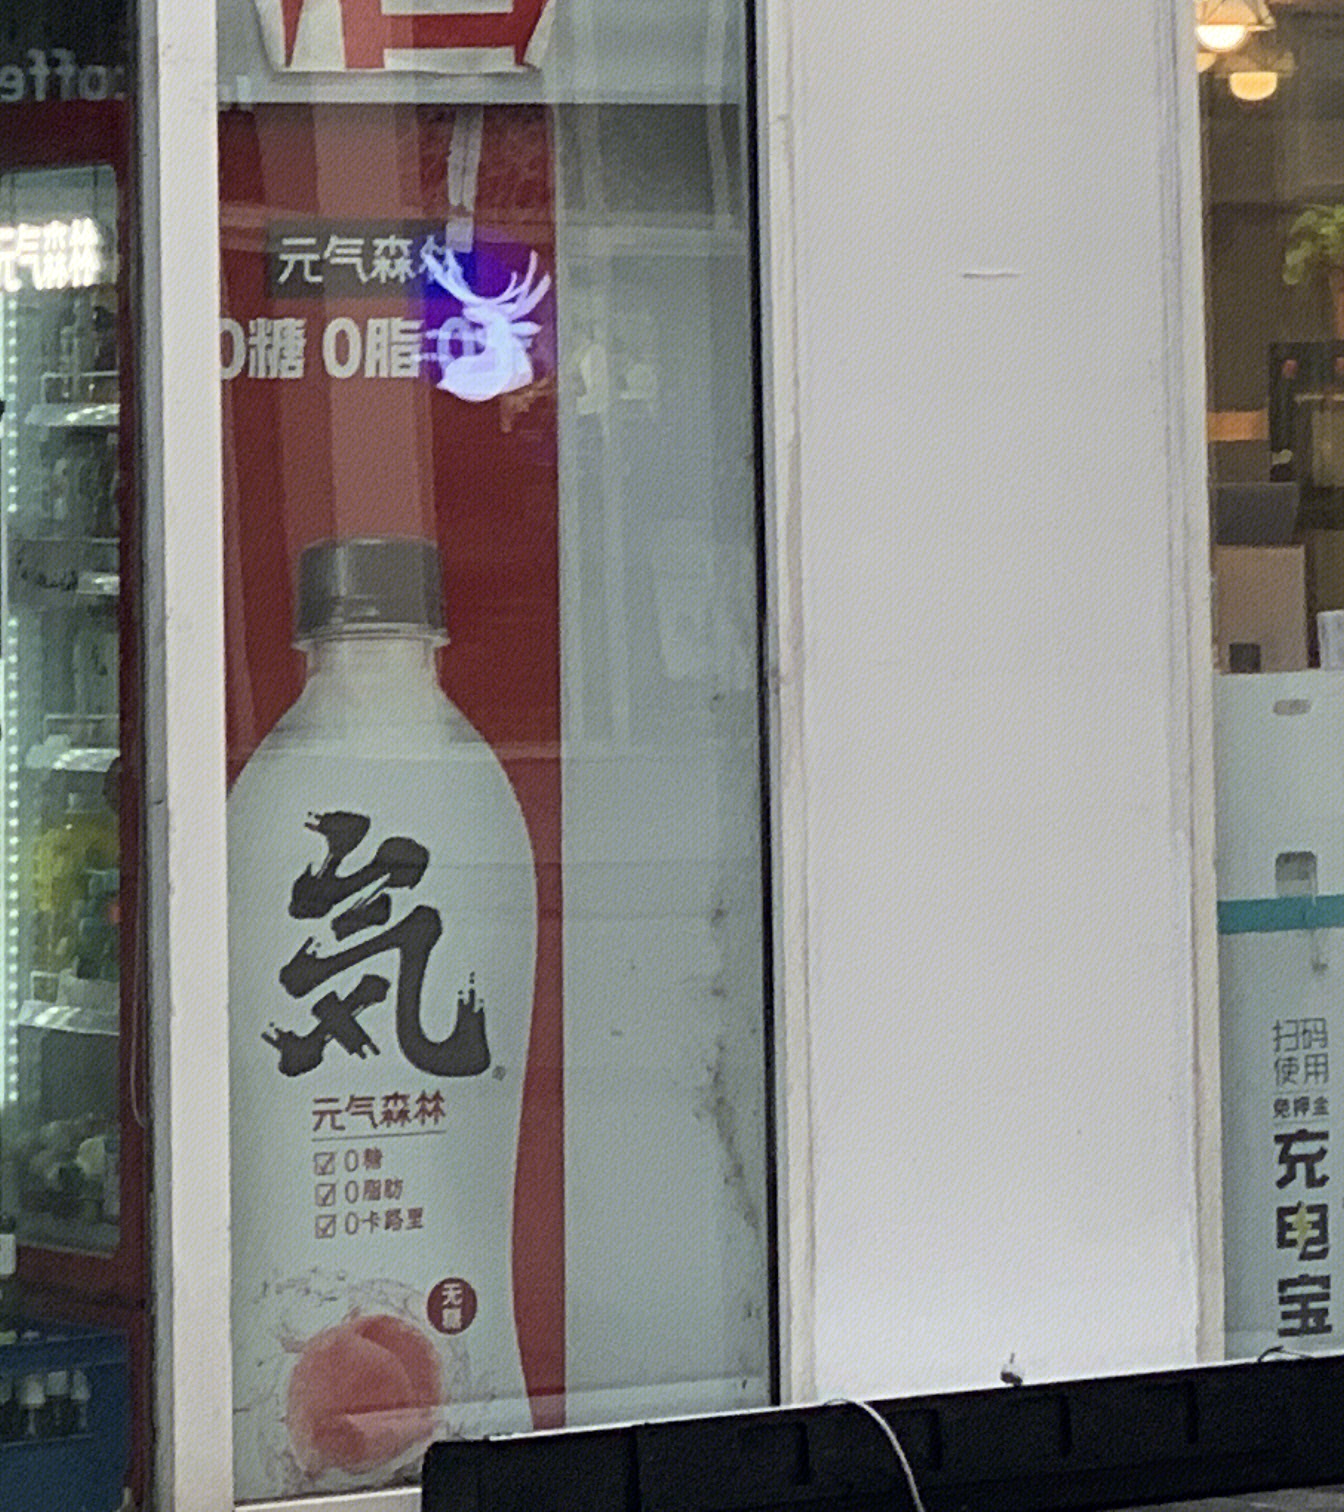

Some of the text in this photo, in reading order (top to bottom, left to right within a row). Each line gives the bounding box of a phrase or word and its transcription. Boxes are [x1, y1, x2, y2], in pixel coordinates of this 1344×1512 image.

[1272, 1018, 1329, 1054] 扫码
[1273, 1053, 1330, 1087] 使用
[312, 1090, 447, 1132] 元气森林
[1272, 1094, 1330, 1120] 免押金
[1273, 1128, 1332, 1338] 充电宝
